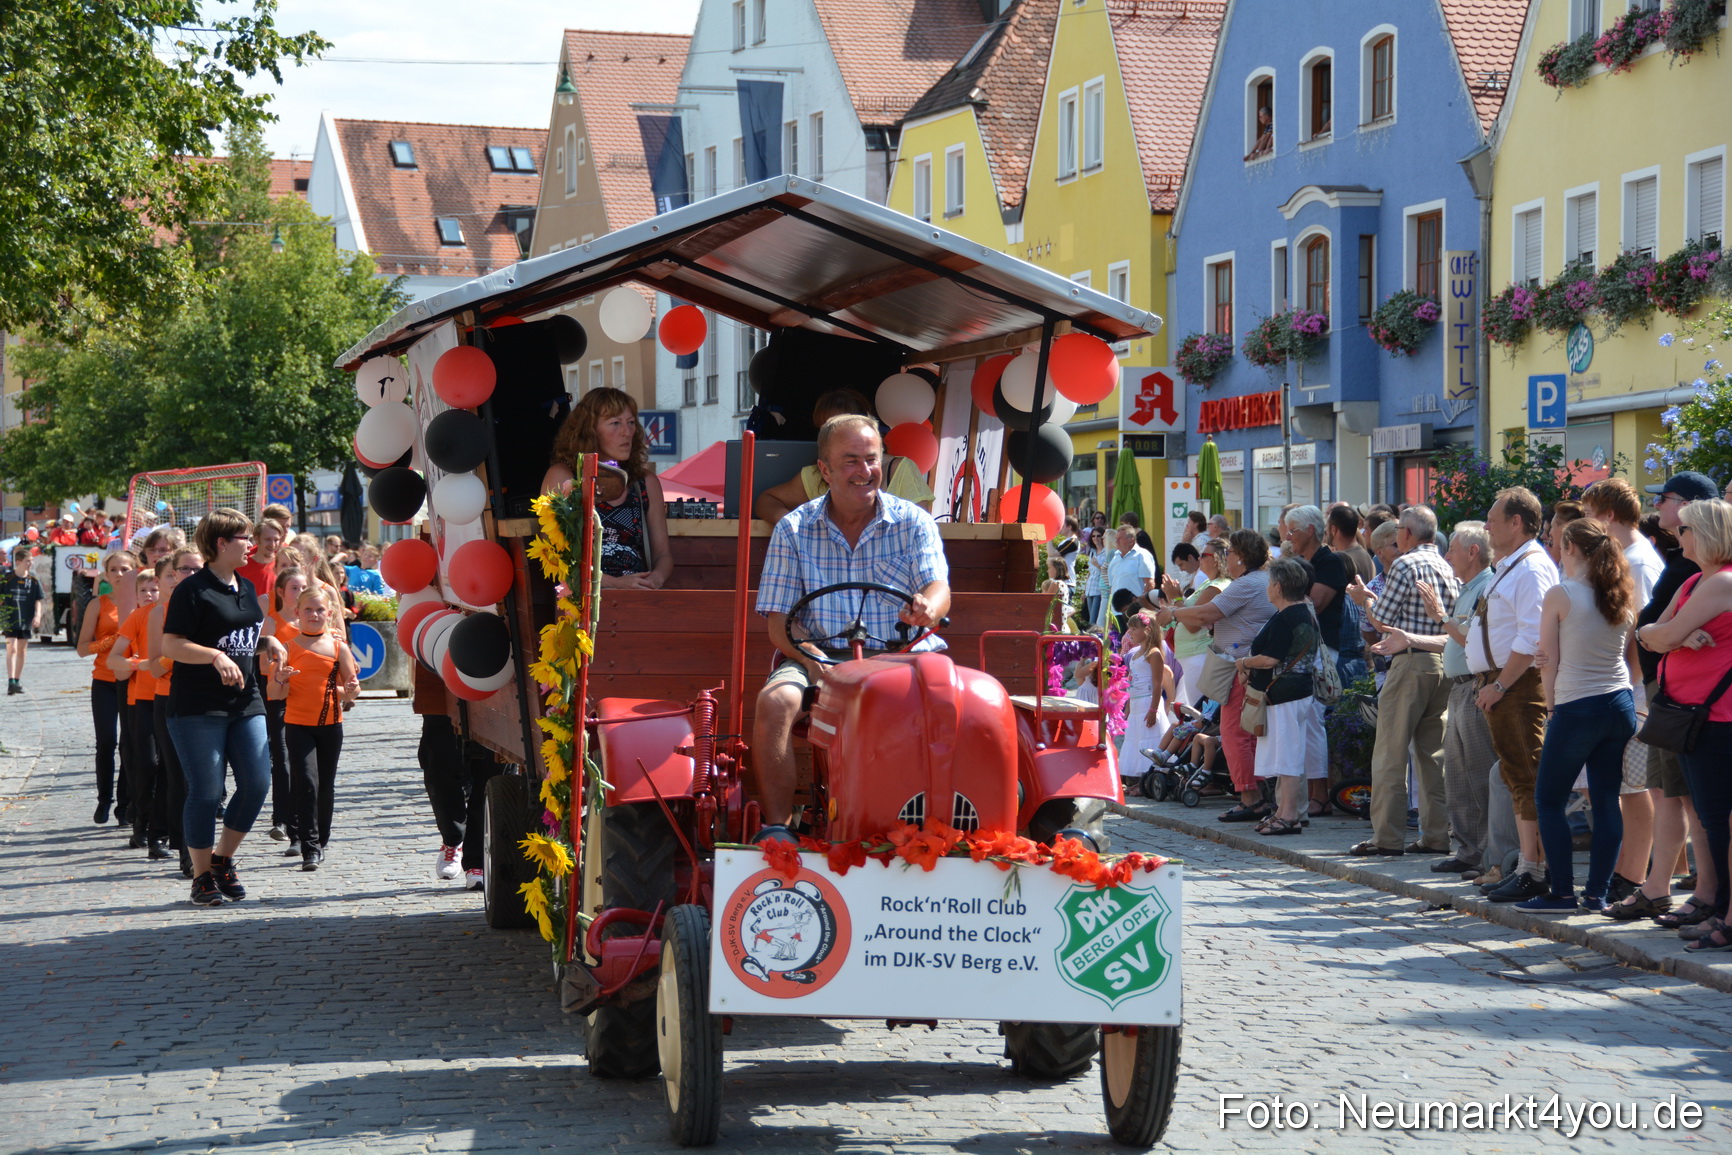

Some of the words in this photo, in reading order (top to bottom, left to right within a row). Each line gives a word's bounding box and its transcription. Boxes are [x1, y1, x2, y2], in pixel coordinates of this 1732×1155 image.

[1451, 252, 1475, 275] CAFÉ
[1452, 280, 1472, 386] WITTL
[1569, 328, 1589, 376] FASS
[1537, 381, 1558, 423] P
[729, 902, 744, 922] Berg
[766, 907, 789, 920] Club
[987, 898, 1027, 915] Club
[1074, 889, 1122, 935] DJK
[948, 925, 978, 941] the
[1072, 934, 1115, 971] BERG
[1122, 904, 1156, 932] OPF.
[864, 950, 887, 967] im
[893, 952, 956, 969] DJK-SV
[962, 954, 1002, 974] Berg
[1007, 955, 1039, 971] e.V.
[1104, 940, 1150, 990] SV
